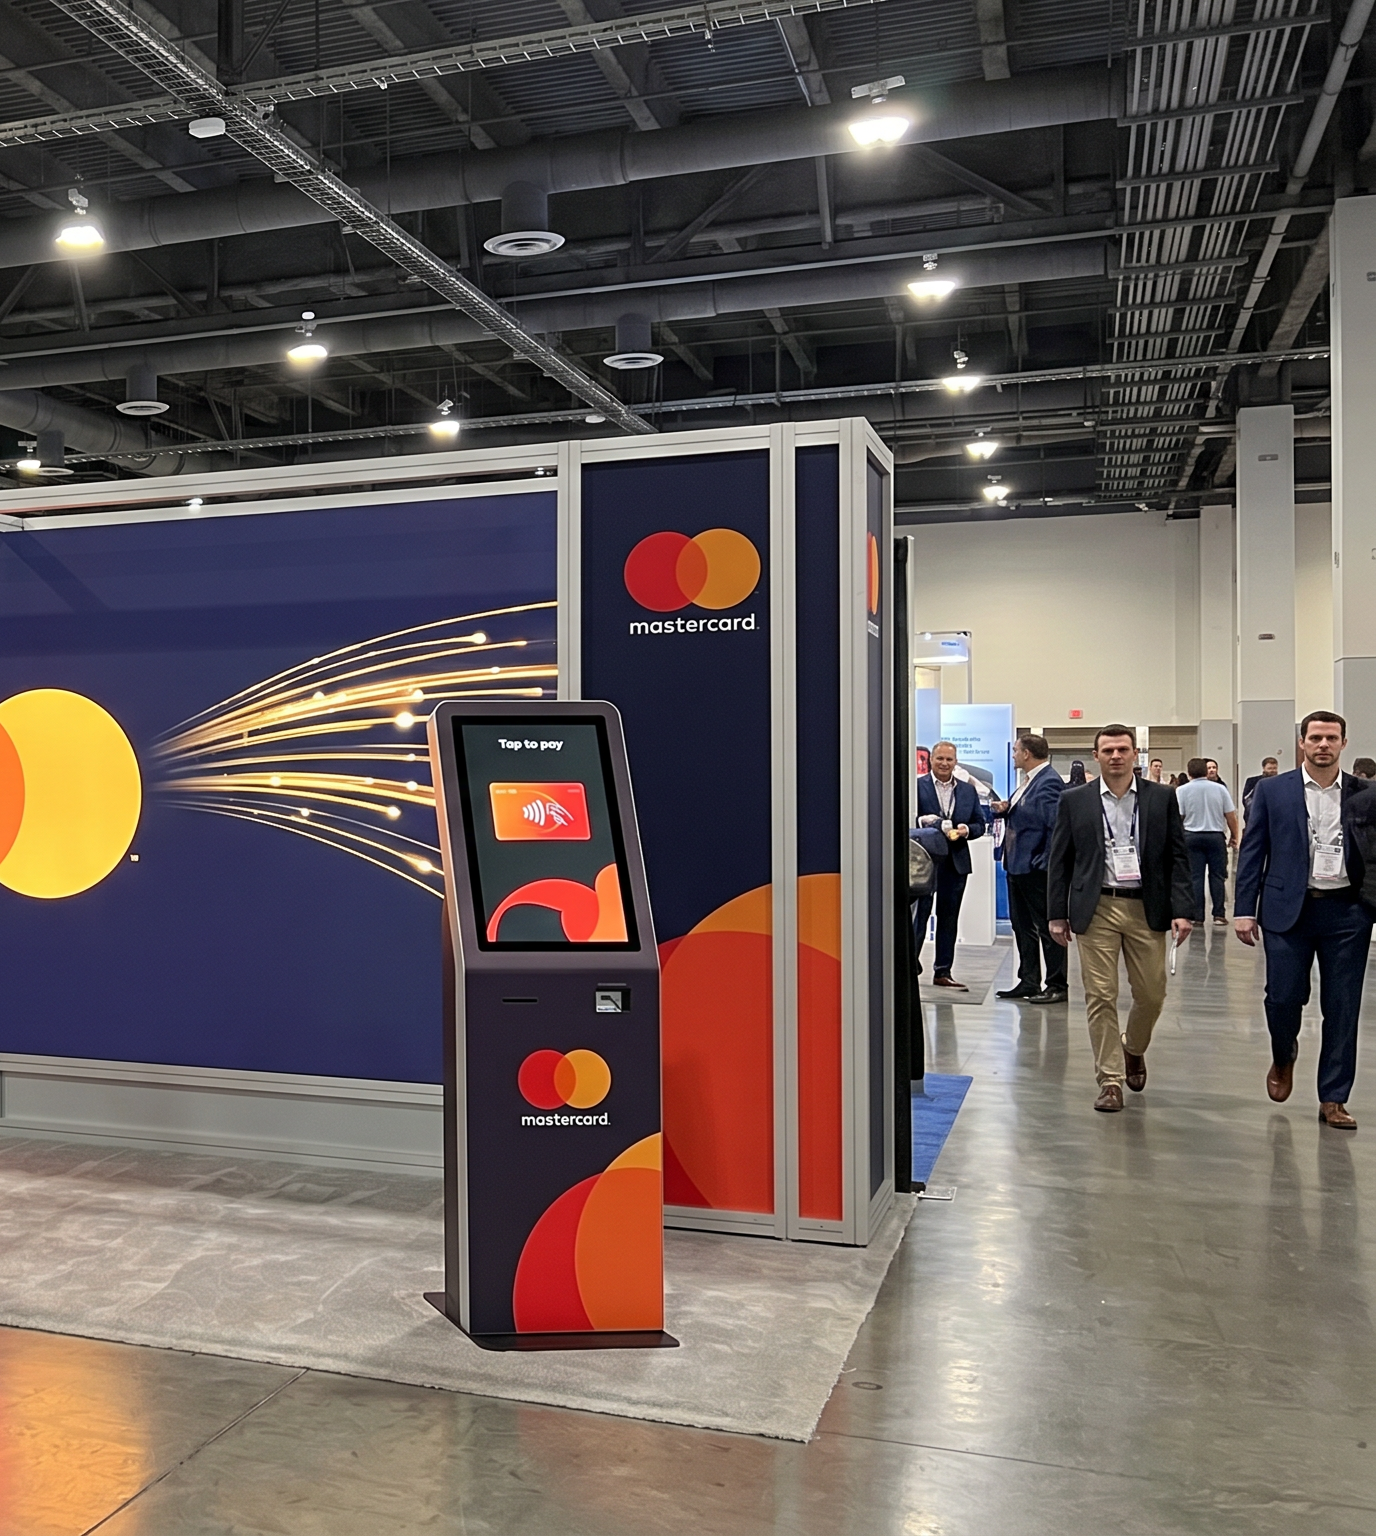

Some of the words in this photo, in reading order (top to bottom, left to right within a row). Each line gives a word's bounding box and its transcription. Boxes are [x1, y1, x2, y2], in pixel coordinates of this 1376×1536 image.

[629, 613, 755, 635] mastercard
[498, 739, 523, 751] Tap
[524, 739, 539, 749] to
[540, 740, 564, 751] pay
[521, 1112, 609, 1126] mastercard
